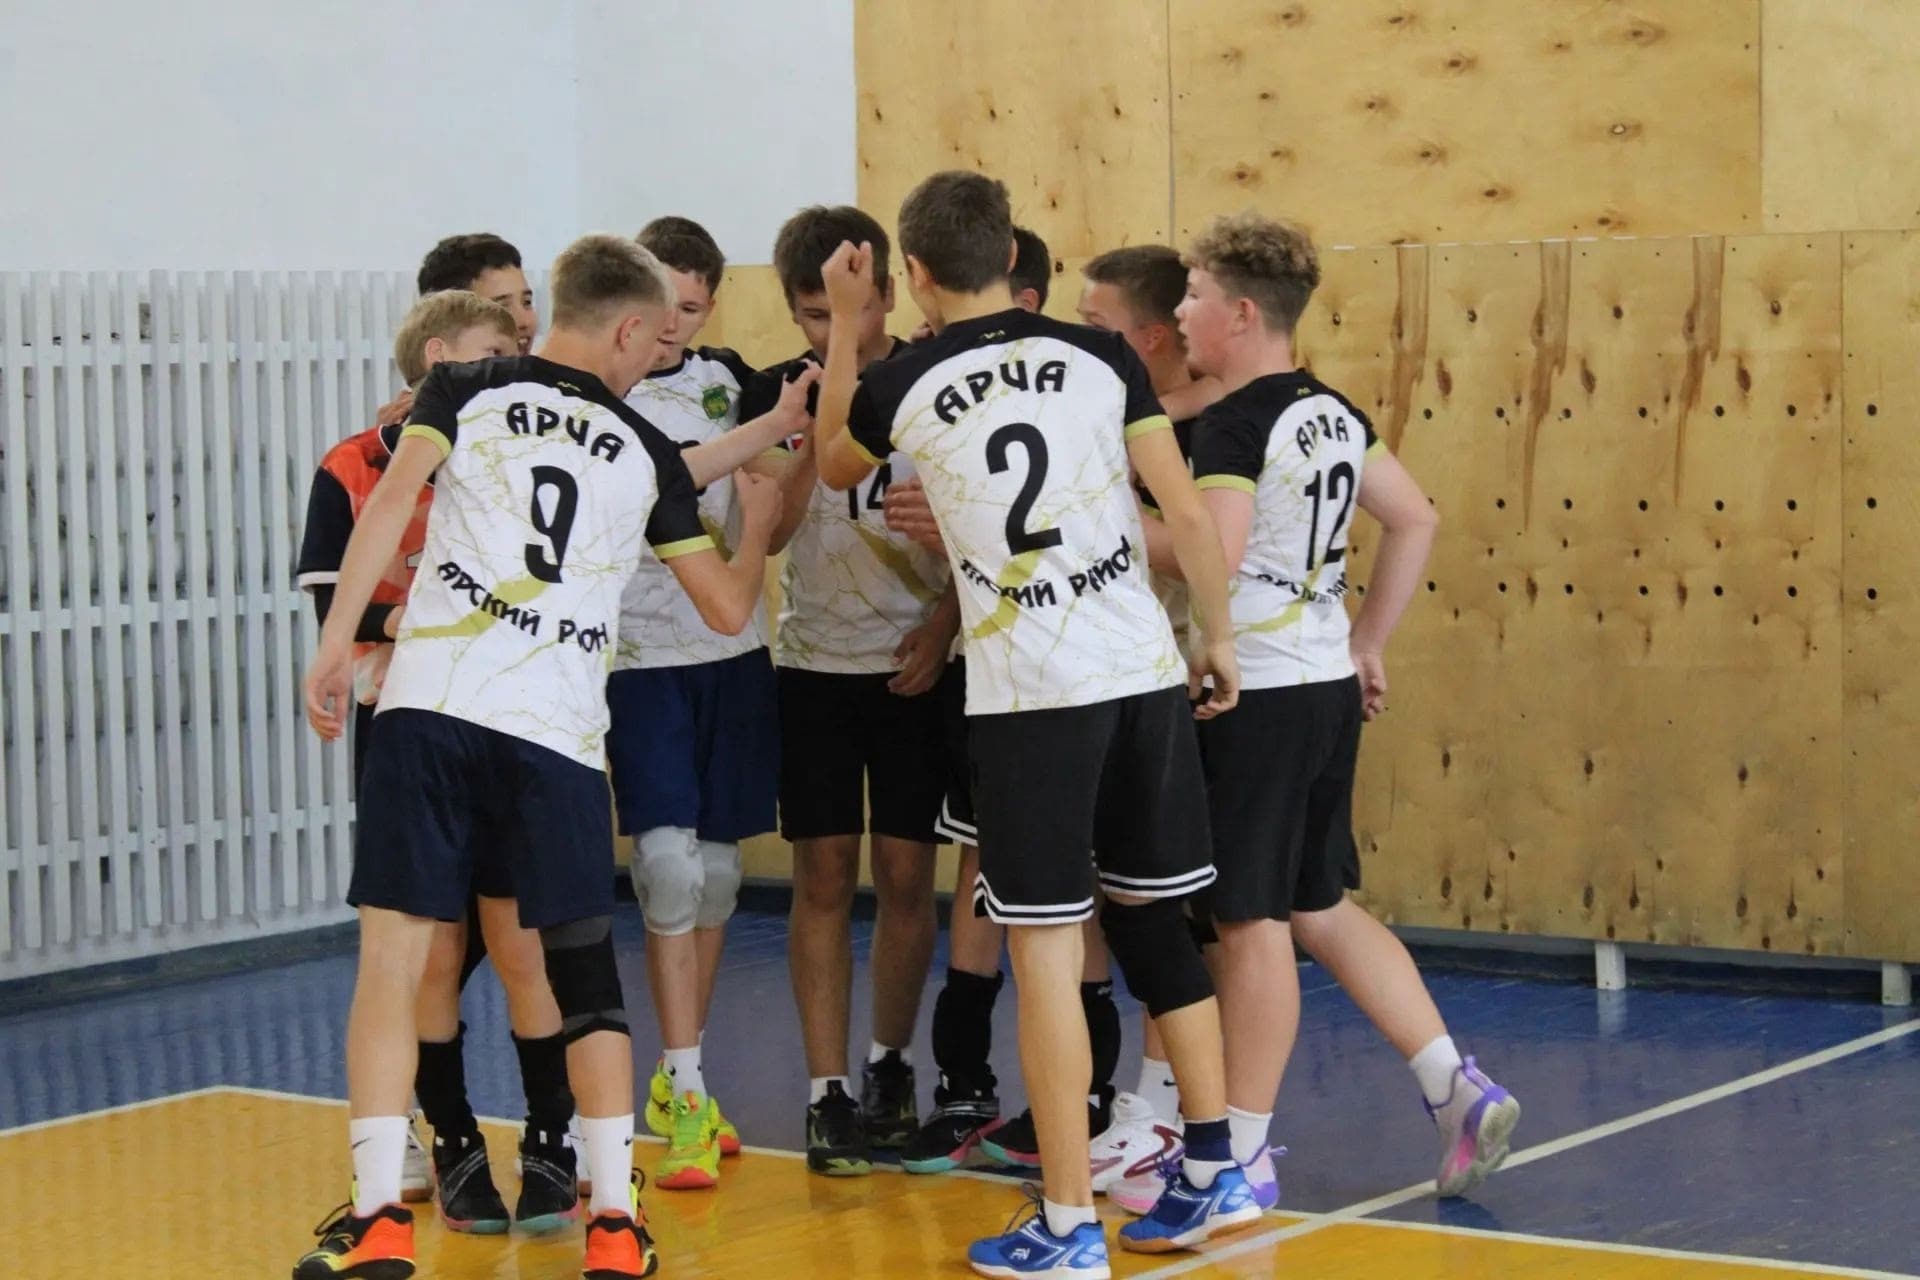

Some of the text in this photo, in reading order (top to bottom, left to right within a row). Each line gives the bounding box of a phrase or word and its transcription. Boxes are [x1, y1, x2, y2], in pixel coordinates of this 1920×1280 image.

[506, 402, 625, 463] АРЧА
[935, 360, 1067, 425] АРЧА
[524, 465, 578, 584] 9
[985, 422, 1063, 556] 2
[1304, 461, 1355, 571] 12
[437, 561, 541, 637] АРСКИЙ
